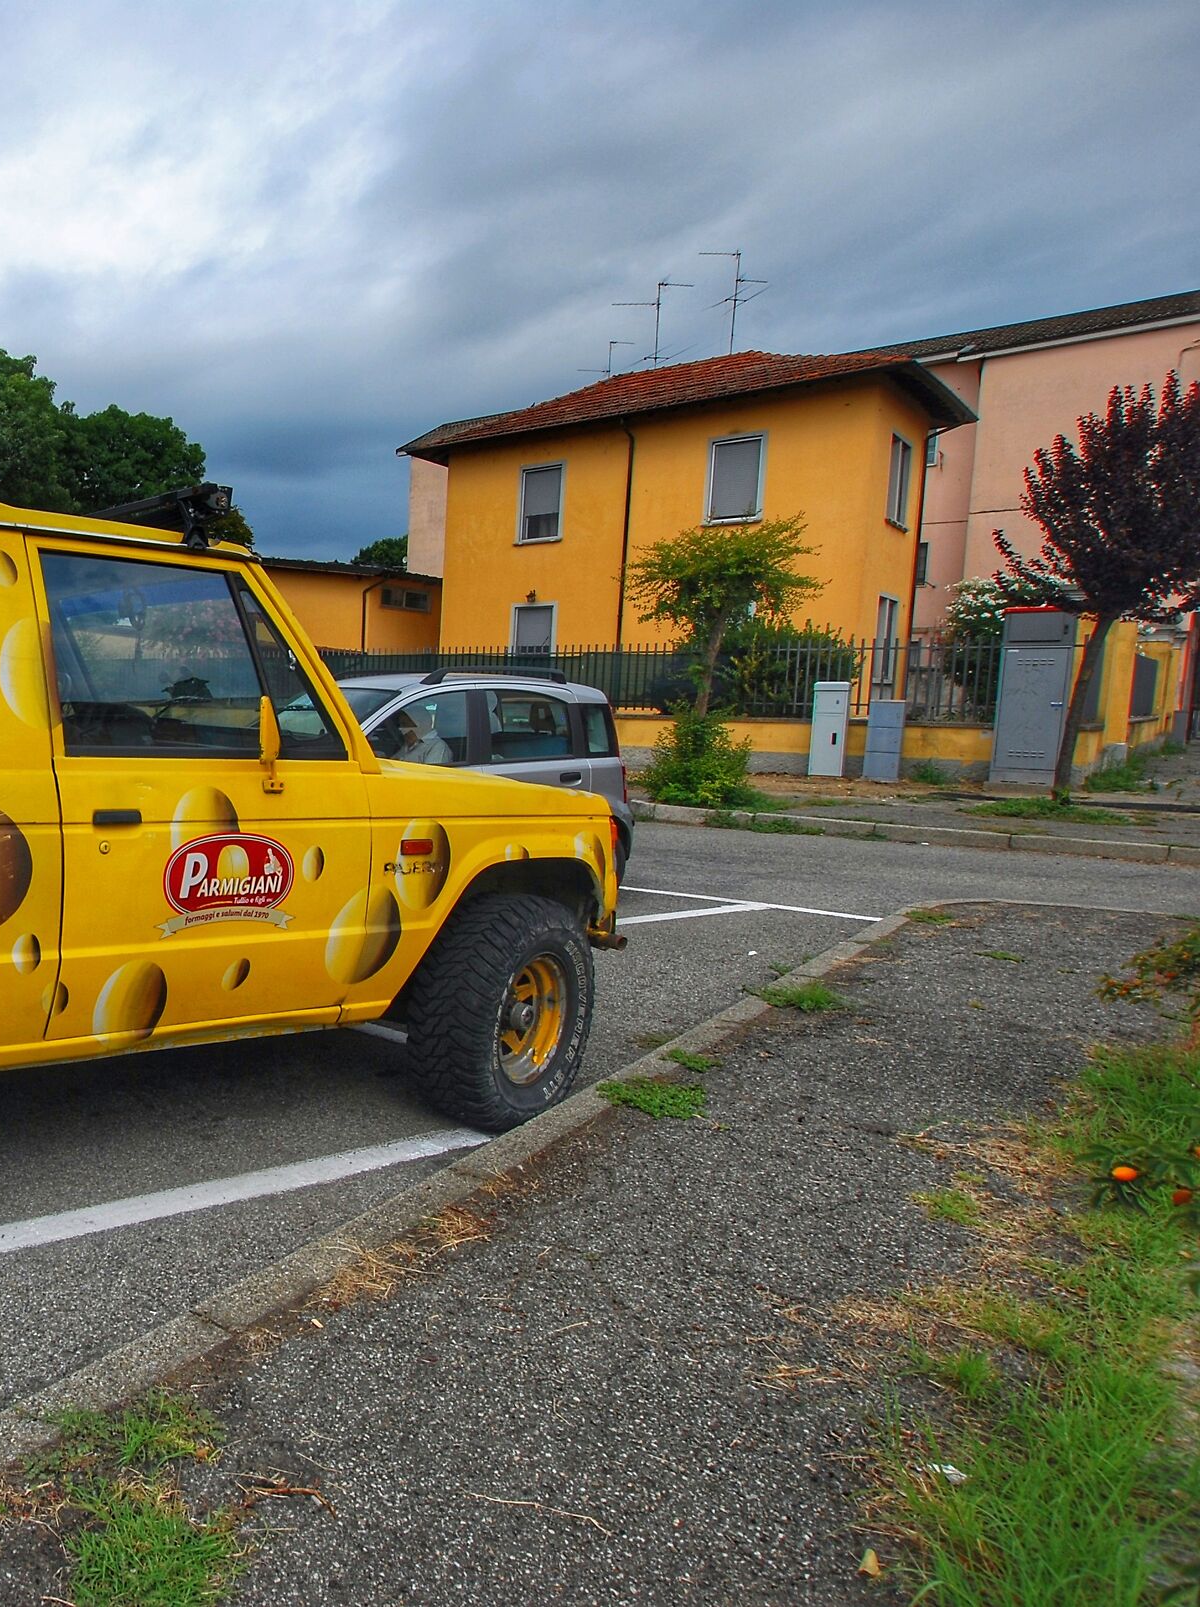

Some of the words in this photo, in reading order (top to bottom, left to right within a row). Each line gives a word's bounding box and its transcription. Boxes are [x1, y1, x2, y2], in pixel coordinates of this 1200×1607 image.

[179, 852, 283, 899] PARMIGIANI
[184, 912, 215, 926] formaggi
[221, 909, 242, 917] salumi
[243, 909, 253, 917] dal
[254, 911, 269, 919] 1970
